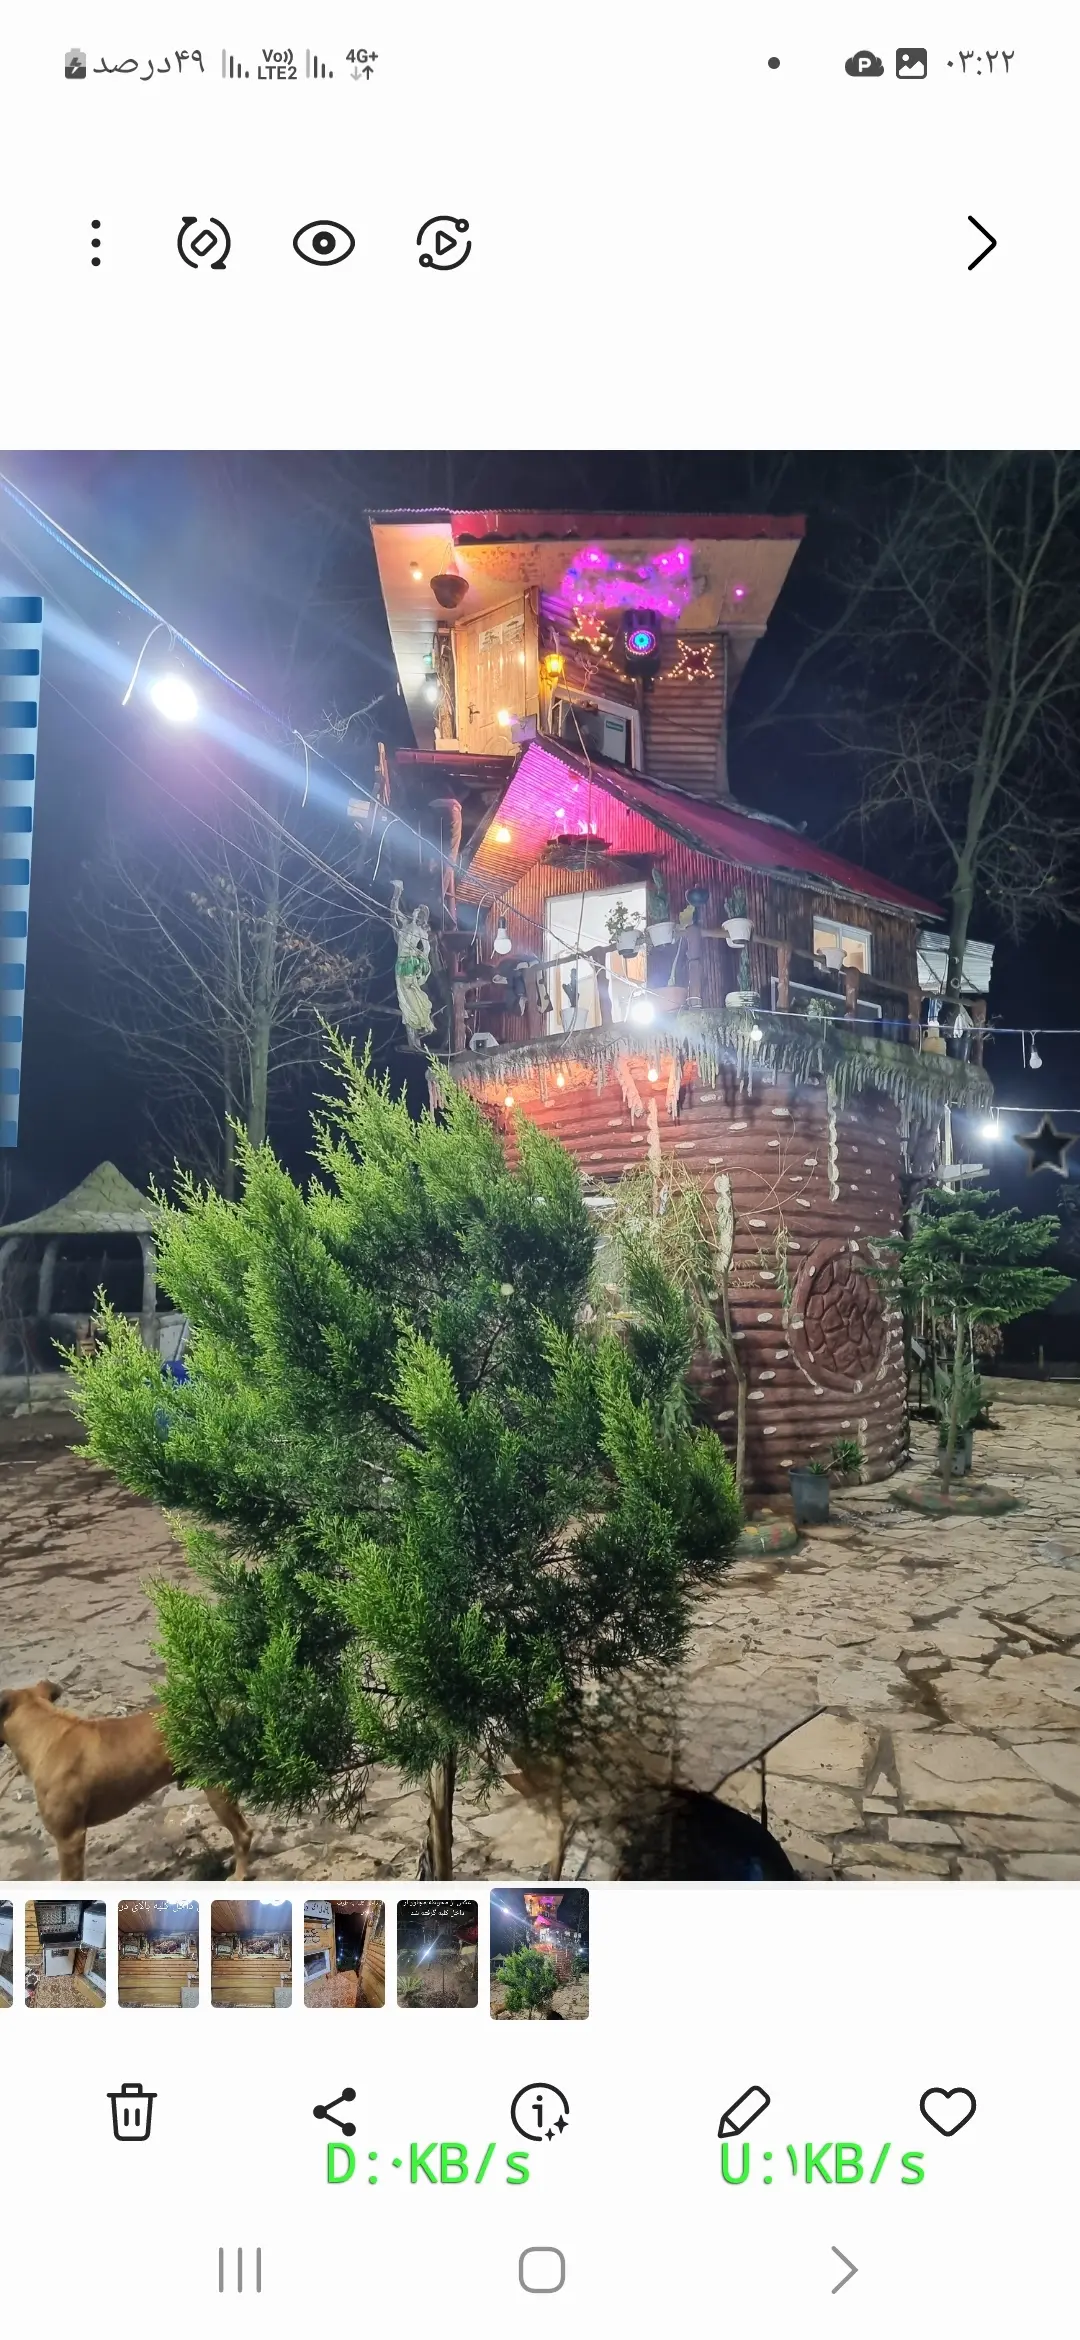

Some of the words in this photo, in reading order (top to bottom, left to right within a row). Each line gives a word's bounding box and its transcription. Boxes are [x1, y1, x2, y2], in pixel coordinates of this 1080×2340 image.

[345, 48, 379, 64] 4G+
[946, 50, 1015, 76] ۰۳:۲۲
[257, 65, 298, 80] LTE2
